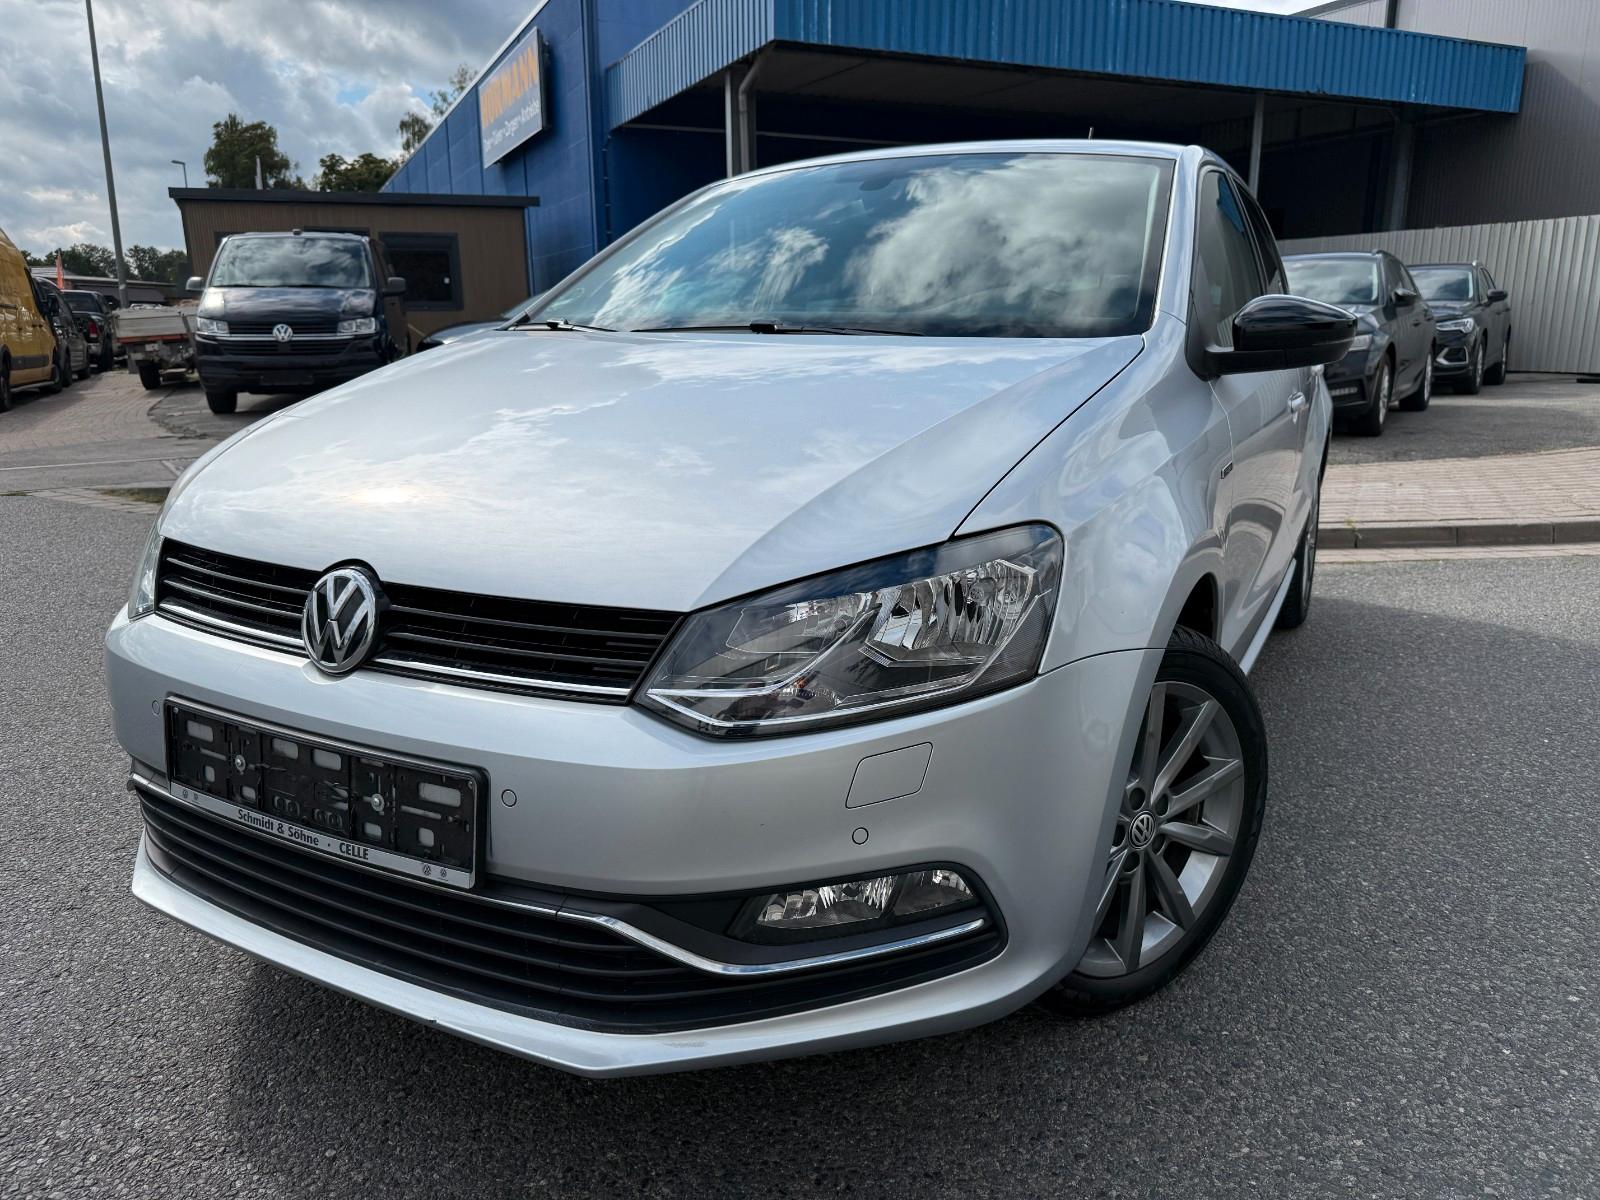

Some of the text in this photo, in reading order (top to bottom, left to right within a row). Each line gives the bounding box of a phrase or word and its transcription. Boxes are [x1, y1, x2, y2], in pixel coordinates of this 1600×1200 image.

[238, 808, 369, 861] Schmidt & Söhne CELLE
